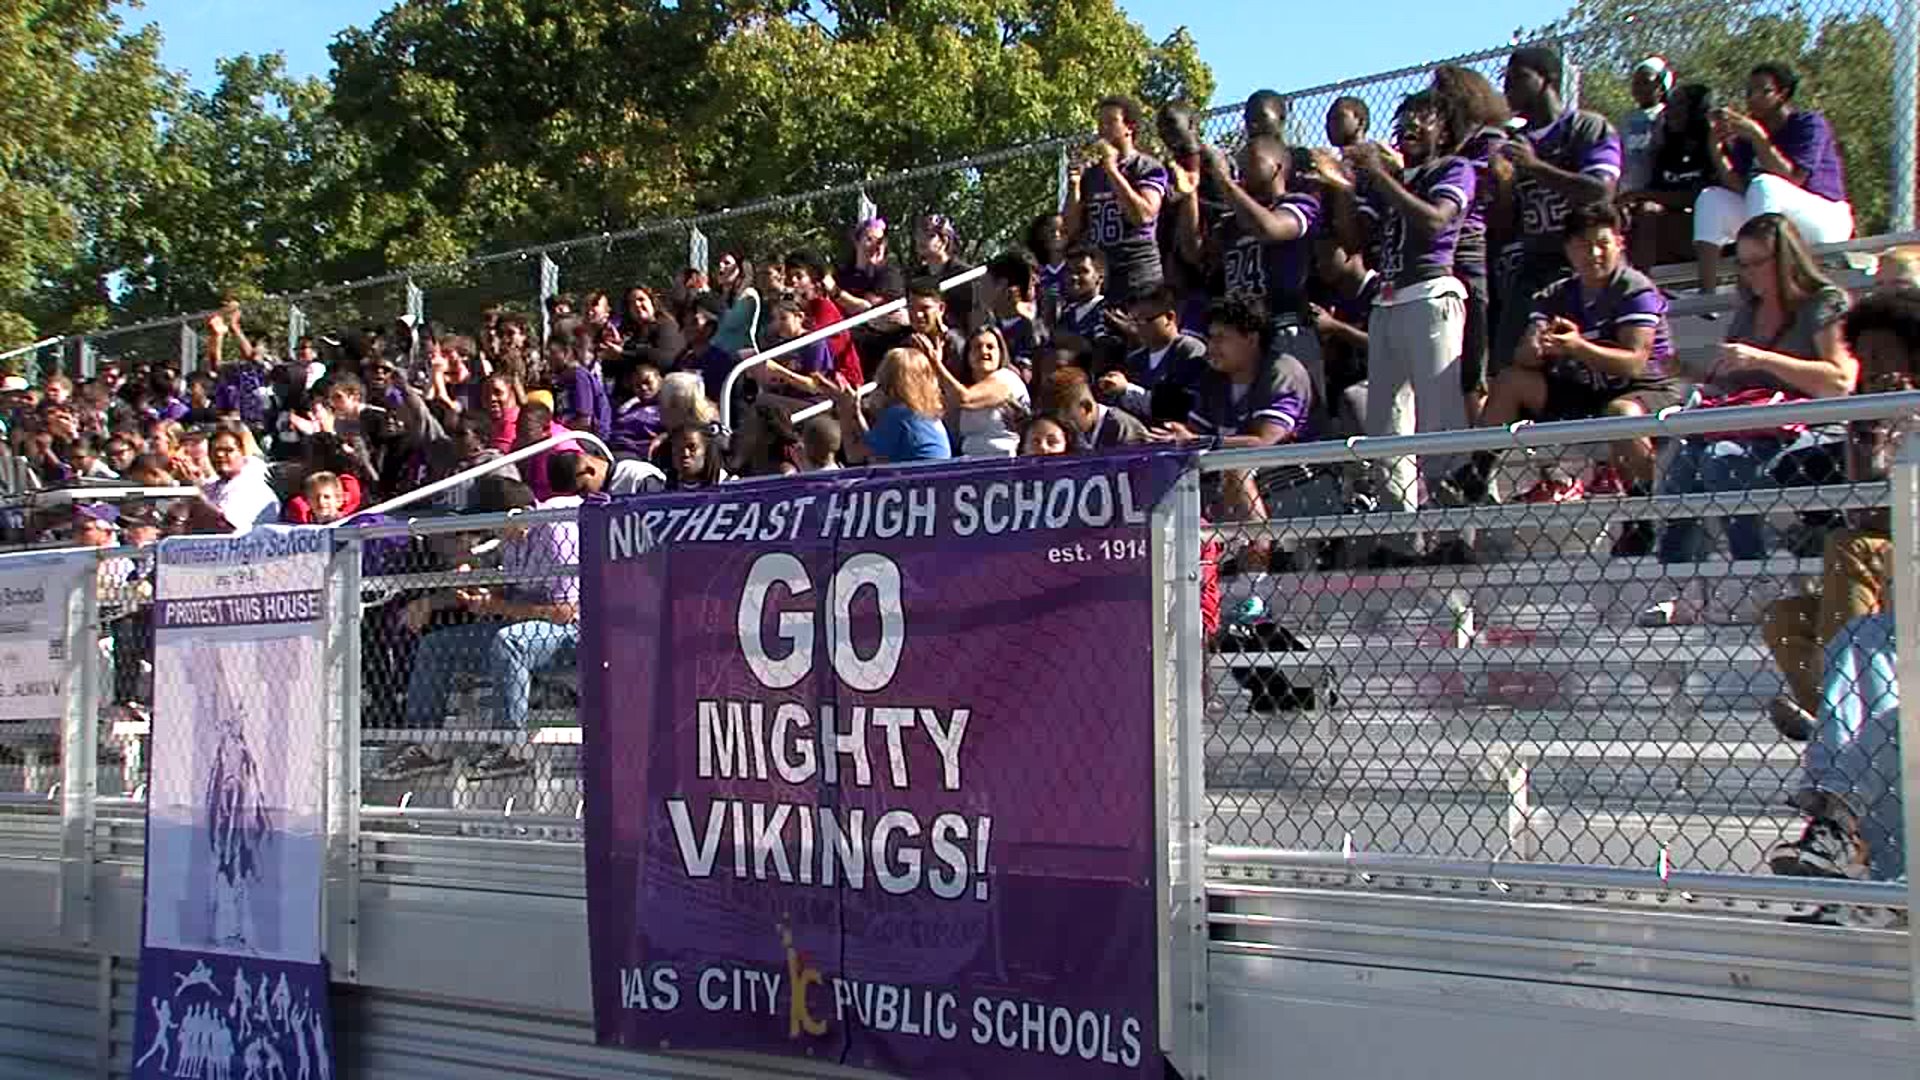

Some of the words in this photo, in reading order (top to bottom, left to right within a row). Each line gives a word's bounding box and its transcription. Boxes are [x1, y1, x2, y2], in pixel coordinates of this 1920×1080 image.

[821, 479, 936, 538] HIGH
[952, 472, 1147, 536] SCHOOL
[1048, 546, 1092, 563] est.
[166, 600, 223, 625] PROTECT
[225, 597, 262, 623] THIS
[263, 593, 321, 620] HOUSE
[737, 552, 905, 692] GO
[698, 701, 971, 790] MIGHTY
[667, 799, 993, 901] VIKINGS!
[699, 967, 781, 1016] CITY
[832, 978, 957, 1040] PUBLIC
[971, 997, 1141, 1068] SCHOOLS
